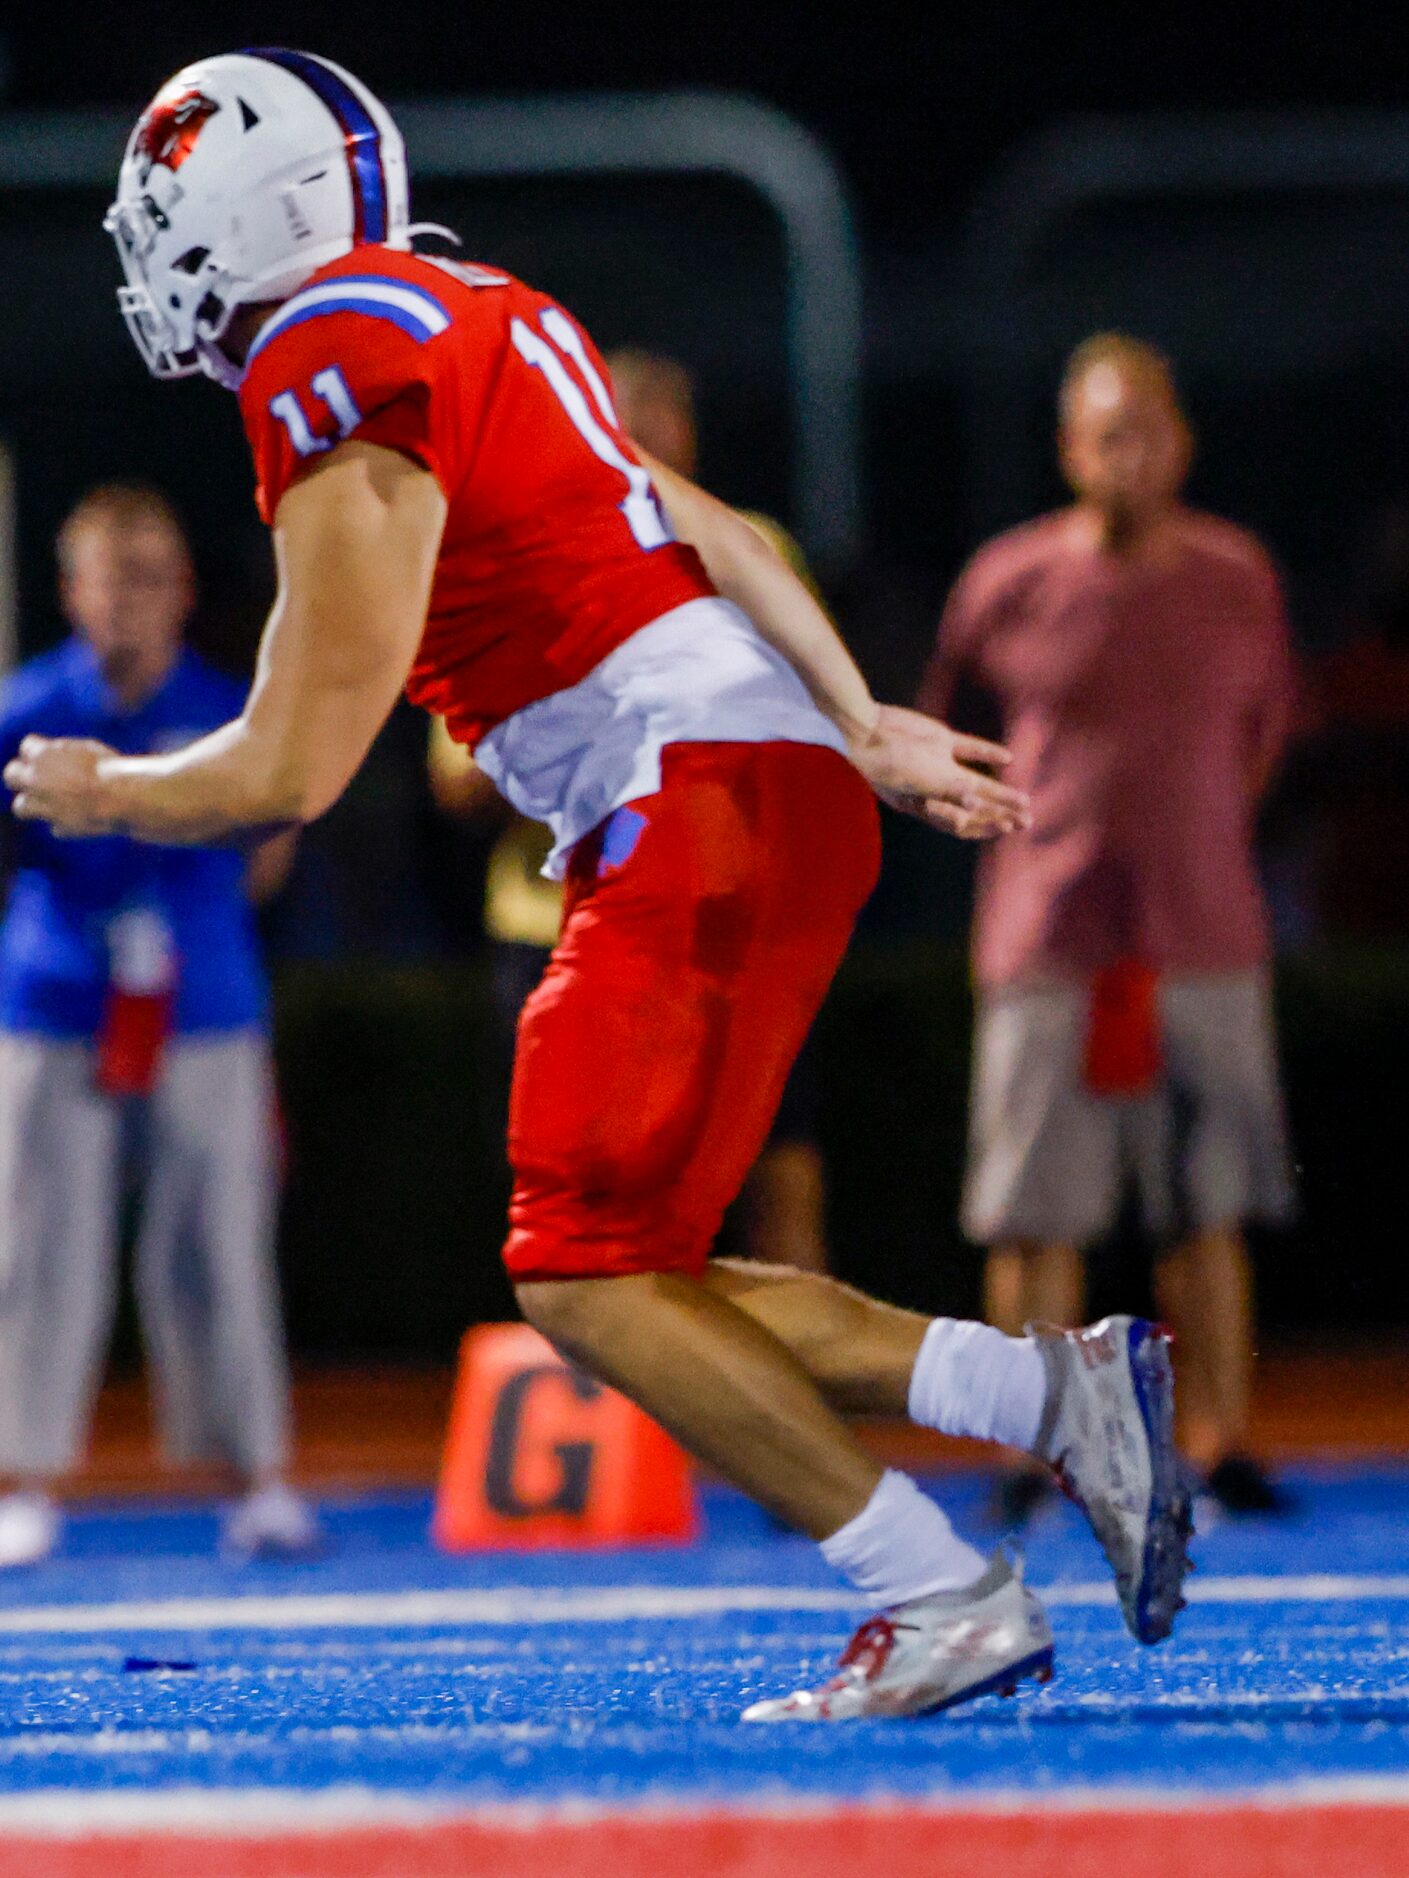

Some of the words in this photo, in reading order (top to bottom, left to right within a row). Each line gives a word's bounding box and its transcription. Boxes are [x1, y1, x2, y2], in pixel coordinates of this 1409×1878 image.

[269, 363, 362, 457] 11
[511, 306, 676, 553] 11
[485, 1364, 601, 1518] G
